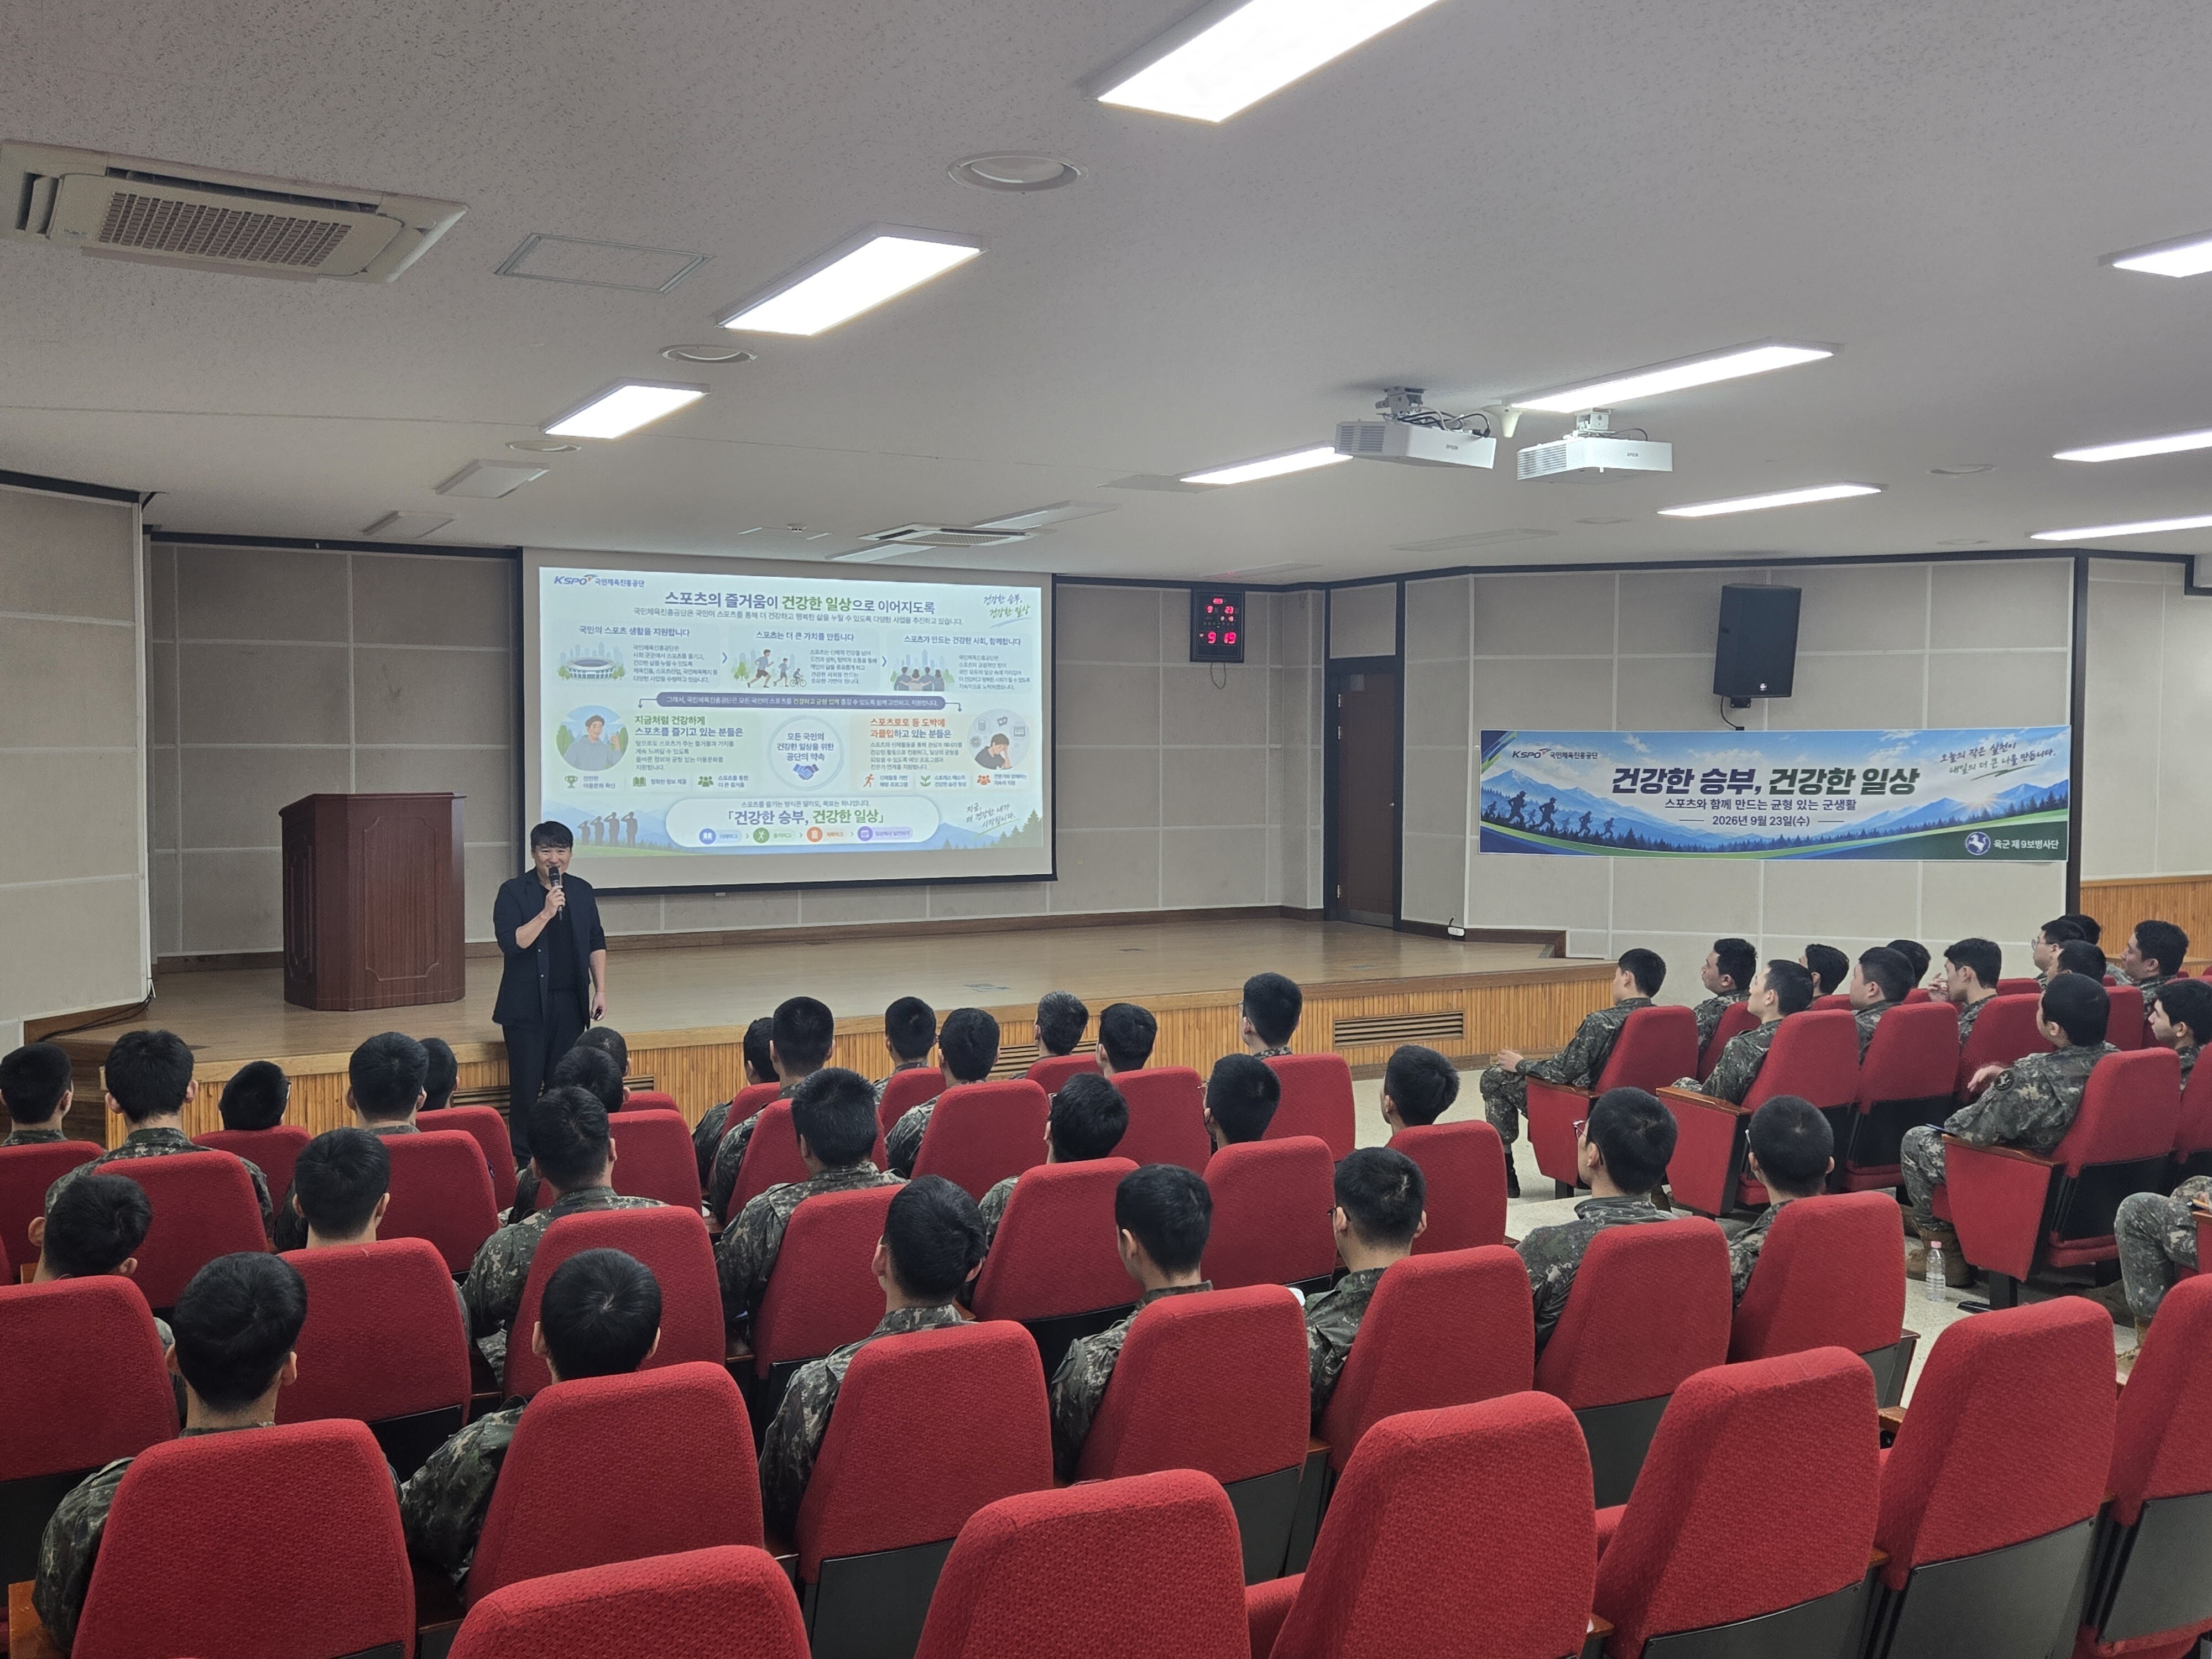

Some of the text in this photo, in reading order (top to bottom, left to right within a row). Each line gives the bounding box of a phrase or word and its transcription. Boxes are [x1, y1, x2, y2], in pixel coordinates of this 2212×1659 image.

[554, 576, 645, 587] KSPO 국민체육진흥공단
[664, 592, 935, 614] 스포츠의 즐거움이 건강한 일상으로 이어지도록
[634, 607, 695, 617] 국민체육진흥공단은
[717, 611, 743, 619] 스포츠를
[745, 611, 758, 619] 통해
[768, 612, 794, 620] 건강하고
[796, 613, 815, 621] 행복한
[893, 616, 911, 624] 사업을
[913, 617, 937, 625] 추진하고
[989, 604, 1031, 619] 건강한 일상
[580, 625, 690, 637] 국민의 스포츠 생활을 지원합니다
[756, 632, 784, 640] 스포츠는
[804, 633, 825, 641] 가치를
[827, 633, 854, 641] 만듭니다
[904, 635, 930, 644] 스포츠가
[931, 636, 951, 644] 만드는
[973, 637, 988, 646] 사회,
[990, 638, 1021, 646] 함께합니다
[1208, 632, 1217, 644] 9
[635, 716, 705, 725] 지금처럼 건강하게
[912, 718, 919, 727] 등
[922, 718, 945, 727] 도박에
[635, 728, 743, 737] 스포츠를 즐기고 있는 분들은
[870, 729, 951, 738] 과몰입하고 있는 분들은
[1940, 742, 2016, 763] 오늘의 작은 실천이
[1949, 748, 2056, 775] 내일의 더 큰 나를 만듭니다.
[1612, 767, 1921, 795] 건강한 승부, 건강한 일상
[1665, 799, 1856, 811] 스포츠와 함께 만드는 균형 있는 군생활
[779, 811, 808, 826] 승부,
[813, 809, 852, 823] 건강한
[1712, 815, 1810, 827] 2026년 9월 23일(수)
